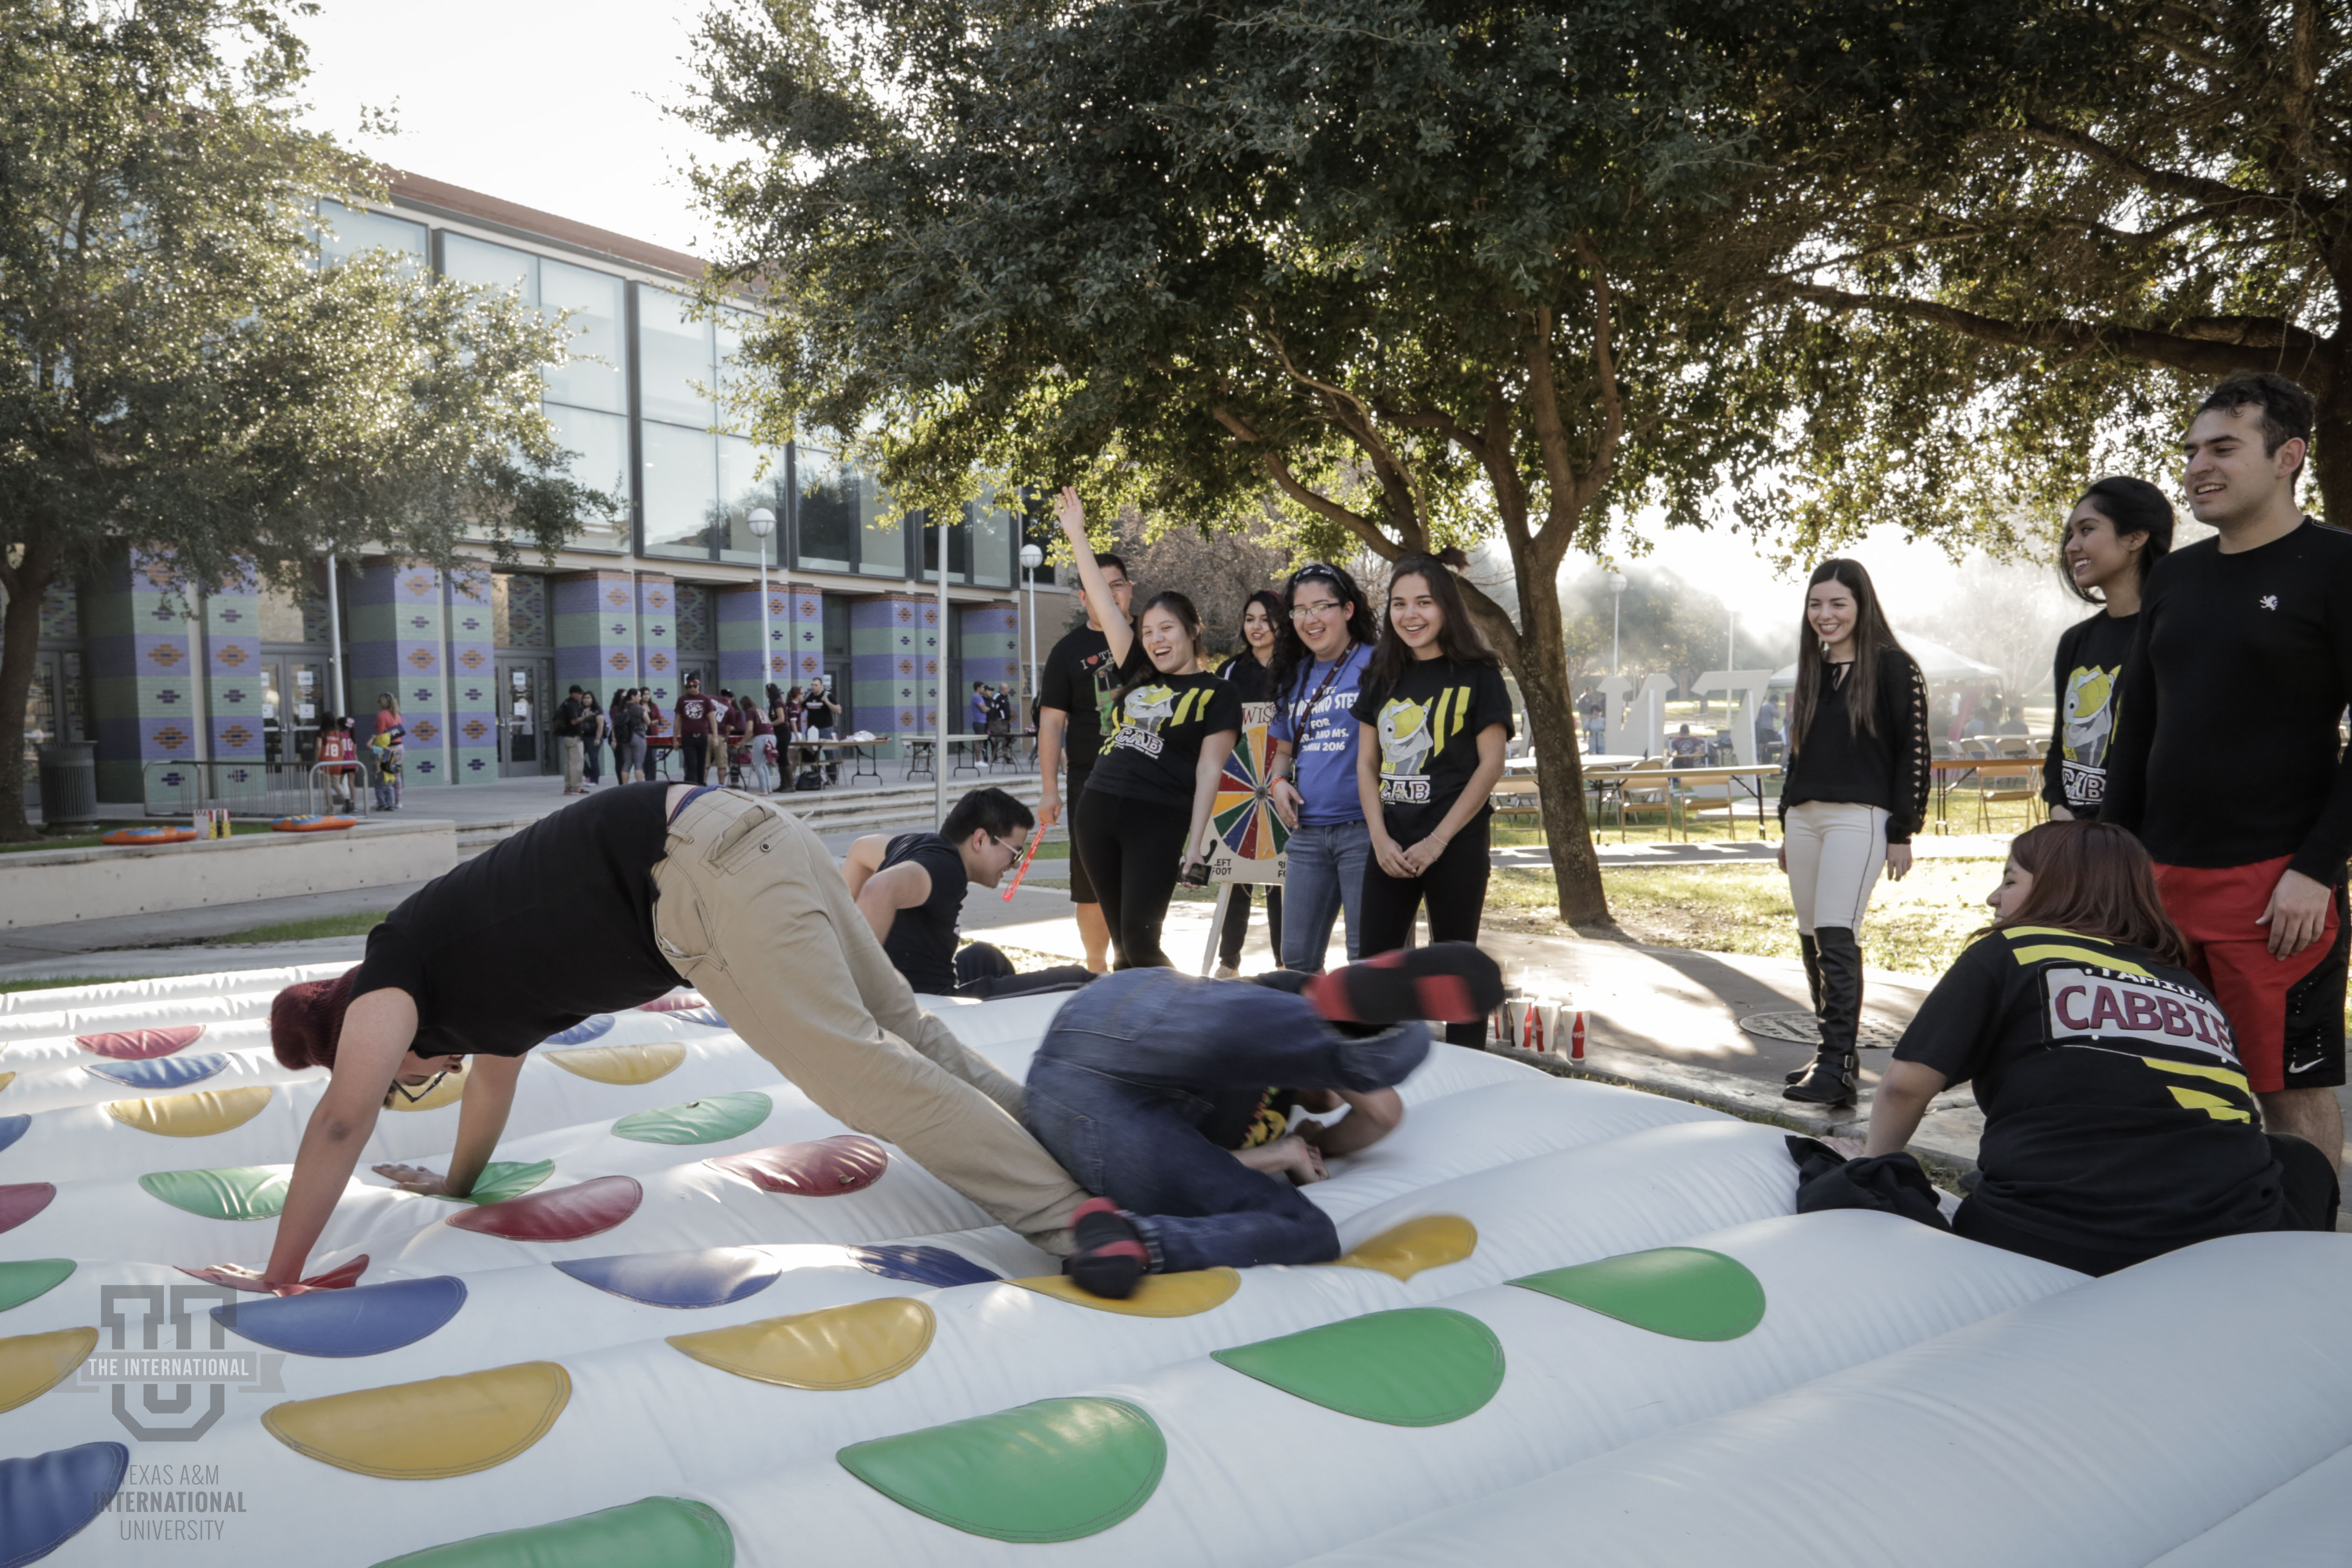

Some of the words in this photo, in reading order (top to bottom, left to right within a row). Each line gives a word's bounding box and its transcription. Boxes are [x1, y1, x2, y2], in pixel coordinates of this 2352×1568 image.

[1080, 659, 1088, 670] I
[1310, 718, 1331, 729] FOR
[1315, 730, 1330, 740] AND
[1332, 728, 1349, 738] MS.
[1114, 727, 1163, 754] CAB
[1322, 741, 1346, 752] 2016
[325, 743, 339, 757] 18
[1381, 779, 1430, 801] CAB
